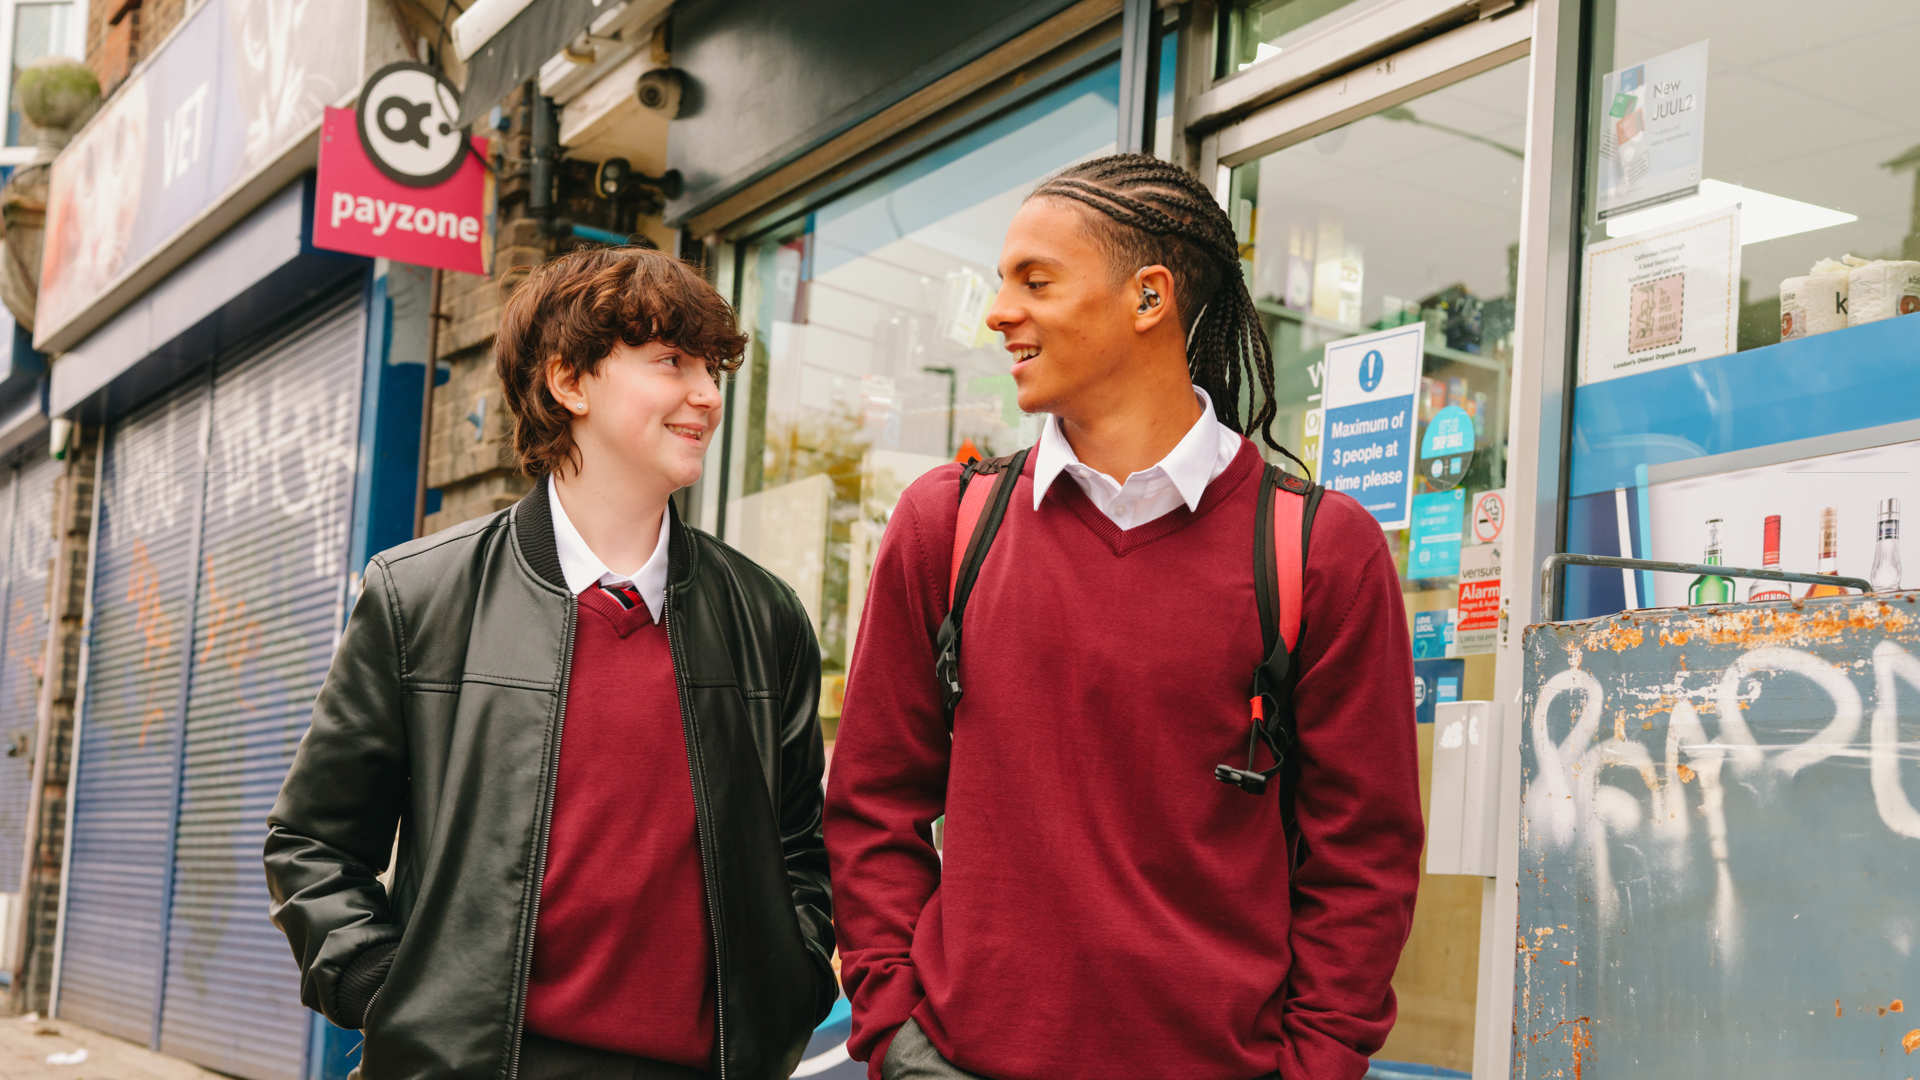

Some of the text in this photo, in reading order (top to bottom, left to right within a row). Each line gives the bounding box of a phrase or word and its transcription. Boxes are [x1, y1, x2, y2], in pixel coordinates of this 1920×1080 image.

[1653, 79, 1681, 98] New
[1651, 94, 1694, 121] JUUL2
[163, 83, 208, 187] VET
[331, 192, 480, 243] payzone
[1331, 417, 1389, 439] Maximum
[1391, 410, 1405, 429] of
[1332, 448, 1341, 465] 3
[1342, 443, 1383, 468] people
[1385, 440, 1398, 458] at
[1325, 469, 1403, 491] a time please
[1462, 565, 1501, 579] verisure
[1461, 583, 1500, 600] Alarm
